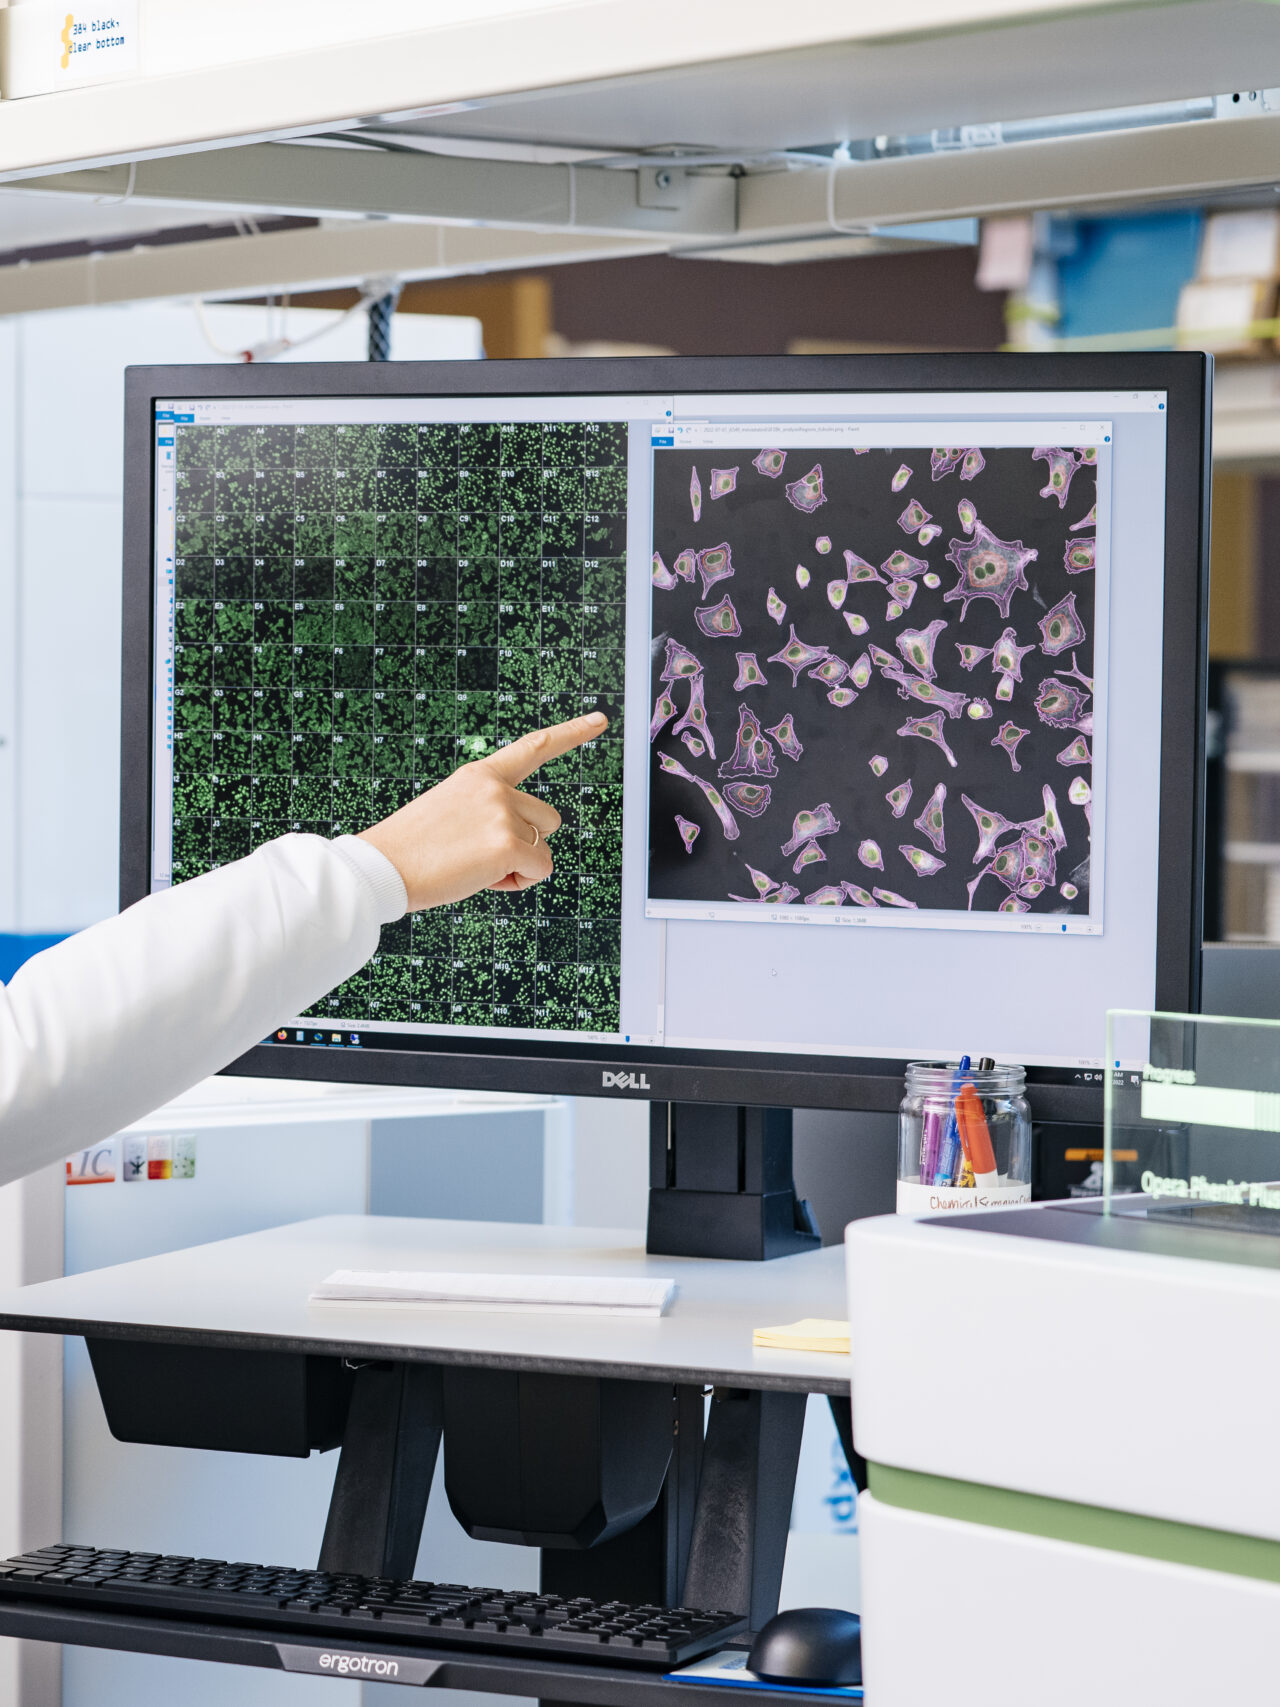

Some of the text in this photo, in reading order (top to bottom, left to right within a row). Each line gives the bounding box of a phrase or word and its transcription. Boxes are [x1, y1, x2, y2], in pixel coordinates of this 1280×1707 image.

[73, 23, 88, 36] 384
[68, 36, 124, 54] clear bottom
[602, 1071, 651, 1090] DELL
[1143, 1064, 1196, 1085] Progress
[1141, 1170, 1188, 1200] Opera
[319, 1654, 399, 1676] ergotron
